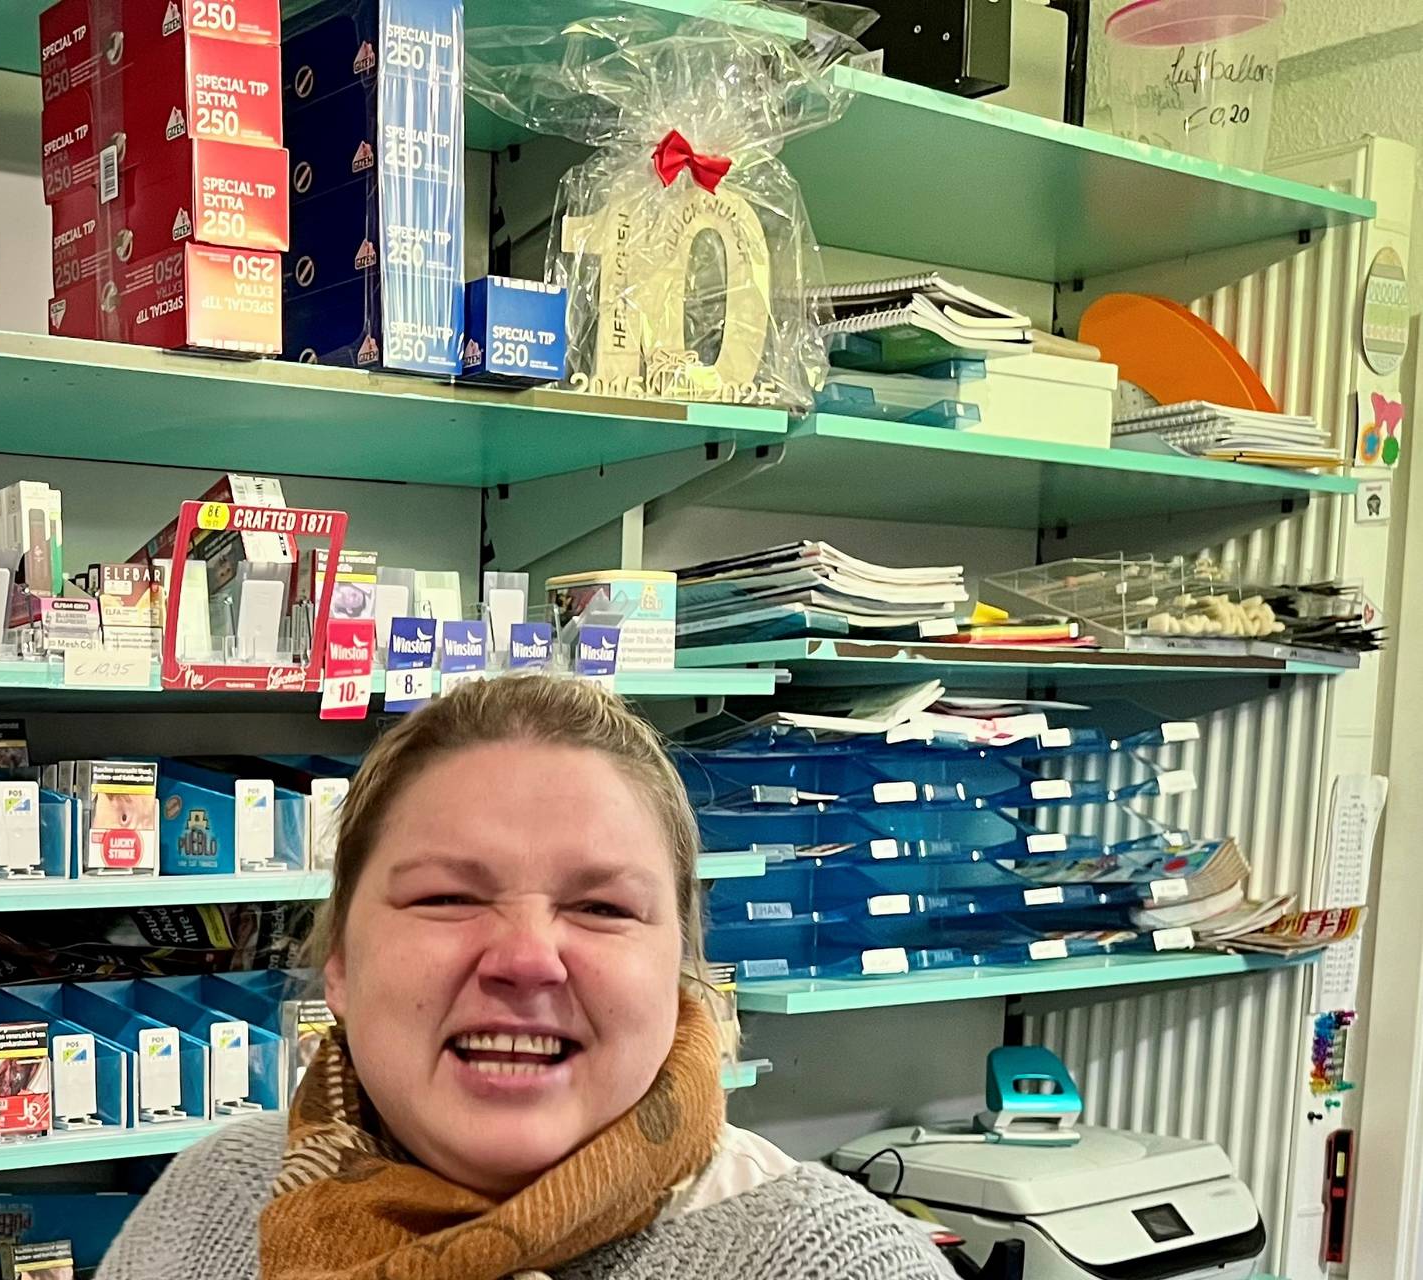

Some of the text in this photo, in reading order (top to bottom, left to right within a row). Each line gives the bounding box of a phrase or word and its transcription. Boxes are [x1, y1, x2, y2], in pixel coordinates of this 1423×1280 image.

[192, 3, 236, 31] 250
[42, 25, 87, 61] SPECIAL TIP
[387, 23, 452, 48] SPECIAL TIP
[386, 40, 425, 71] 250
[44, 68, 70, 101] 250
[195, 73, 269, 97] SPECIAL TIP
[196, 91, 238, 109] EXTRA
[196, 108, 239, 137] 250
[44, 124, 89, 157] SPECIAL TIP
[385, 125, 450, 148] SPECIAL TIP
[384, 141, 423, 170] 250
[45, 166, 73, 197] 250
[203, 177, 276, 199] SPECIAL TIP
[203, 193, 245, 211] EXTRA
[54, 220, 97, 250] SPECIAL TIP
[203, 210, 246, 239] 250
[387, 225, 452, 246] SPECIAL TIP
[387, 239, 425, 268] 250
[55, 259, 81, 288] 250
[156, 253, 183, 284] 250
[233, 254, 275, 283] 250
[235, 281, 274, 298] EXTRA
[136, 296, 184, 325] SPECIAL TIP
[222, 297, 275, 315] SPECIAL
[390, 321, 435, 339] SPECIAL
[492, 326, 556, 346] SPECIAL TIP
[390, 338, 426, 363] 250
[491, 343, 528, 367] 250
[570, 371, 646, 398] 2015
[233, 508, 333, 534] CRAFTED 1871
[103, 566, 162, 582] ELFBAR
[57, 640, 79, 649] Mesh
[330, 642, 368, 661] Winston
[393, 636, 432, 655] Winston
[444, 637, 482, 657] Winston
[512, 640, 547, 659] Winston
[580, 642, 615, 662] Winston
[8, 789, 23, 797] POS
[108, 849, 136, 860] STRIKE
[109, 838, 137, 849] LUCKY
[179, 828, 218, 857] PUEBLO
